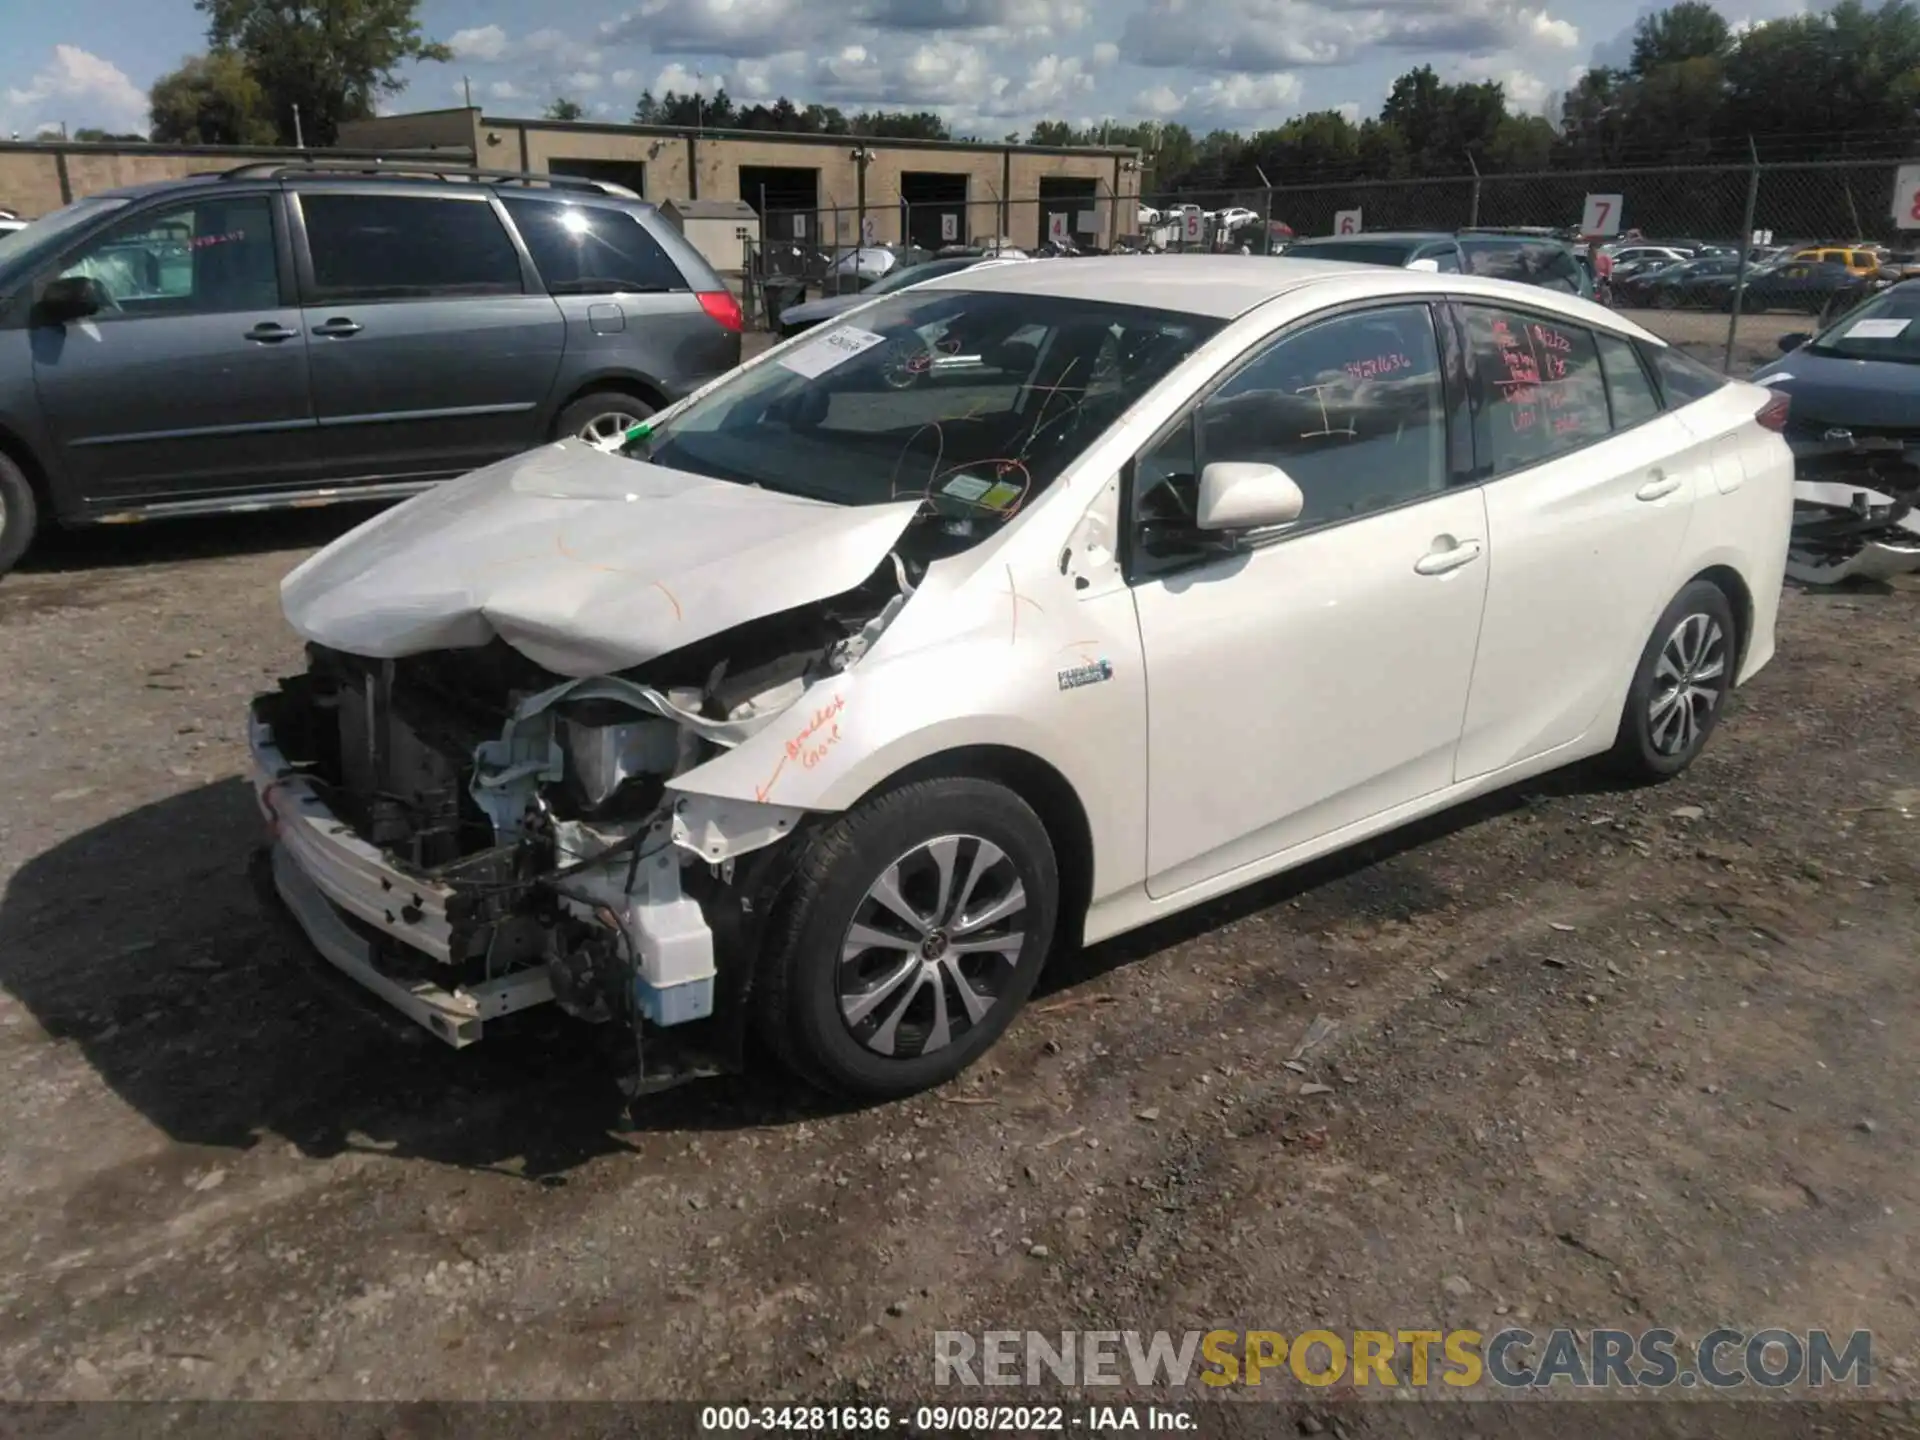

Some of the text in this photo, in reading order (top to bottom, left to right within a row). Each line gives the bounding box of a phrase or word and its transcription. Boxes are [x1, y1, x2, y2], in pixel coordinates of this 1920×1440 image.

[1595, 202, 1611, 229] 7
[866, 221, 874, 238] 2
[944, 219, 954, 236] 3
[1052, 218, 1062, 235] 4
[1187, 215, 1199, 236] 5
[1341, 216, 1354, 235] 6
